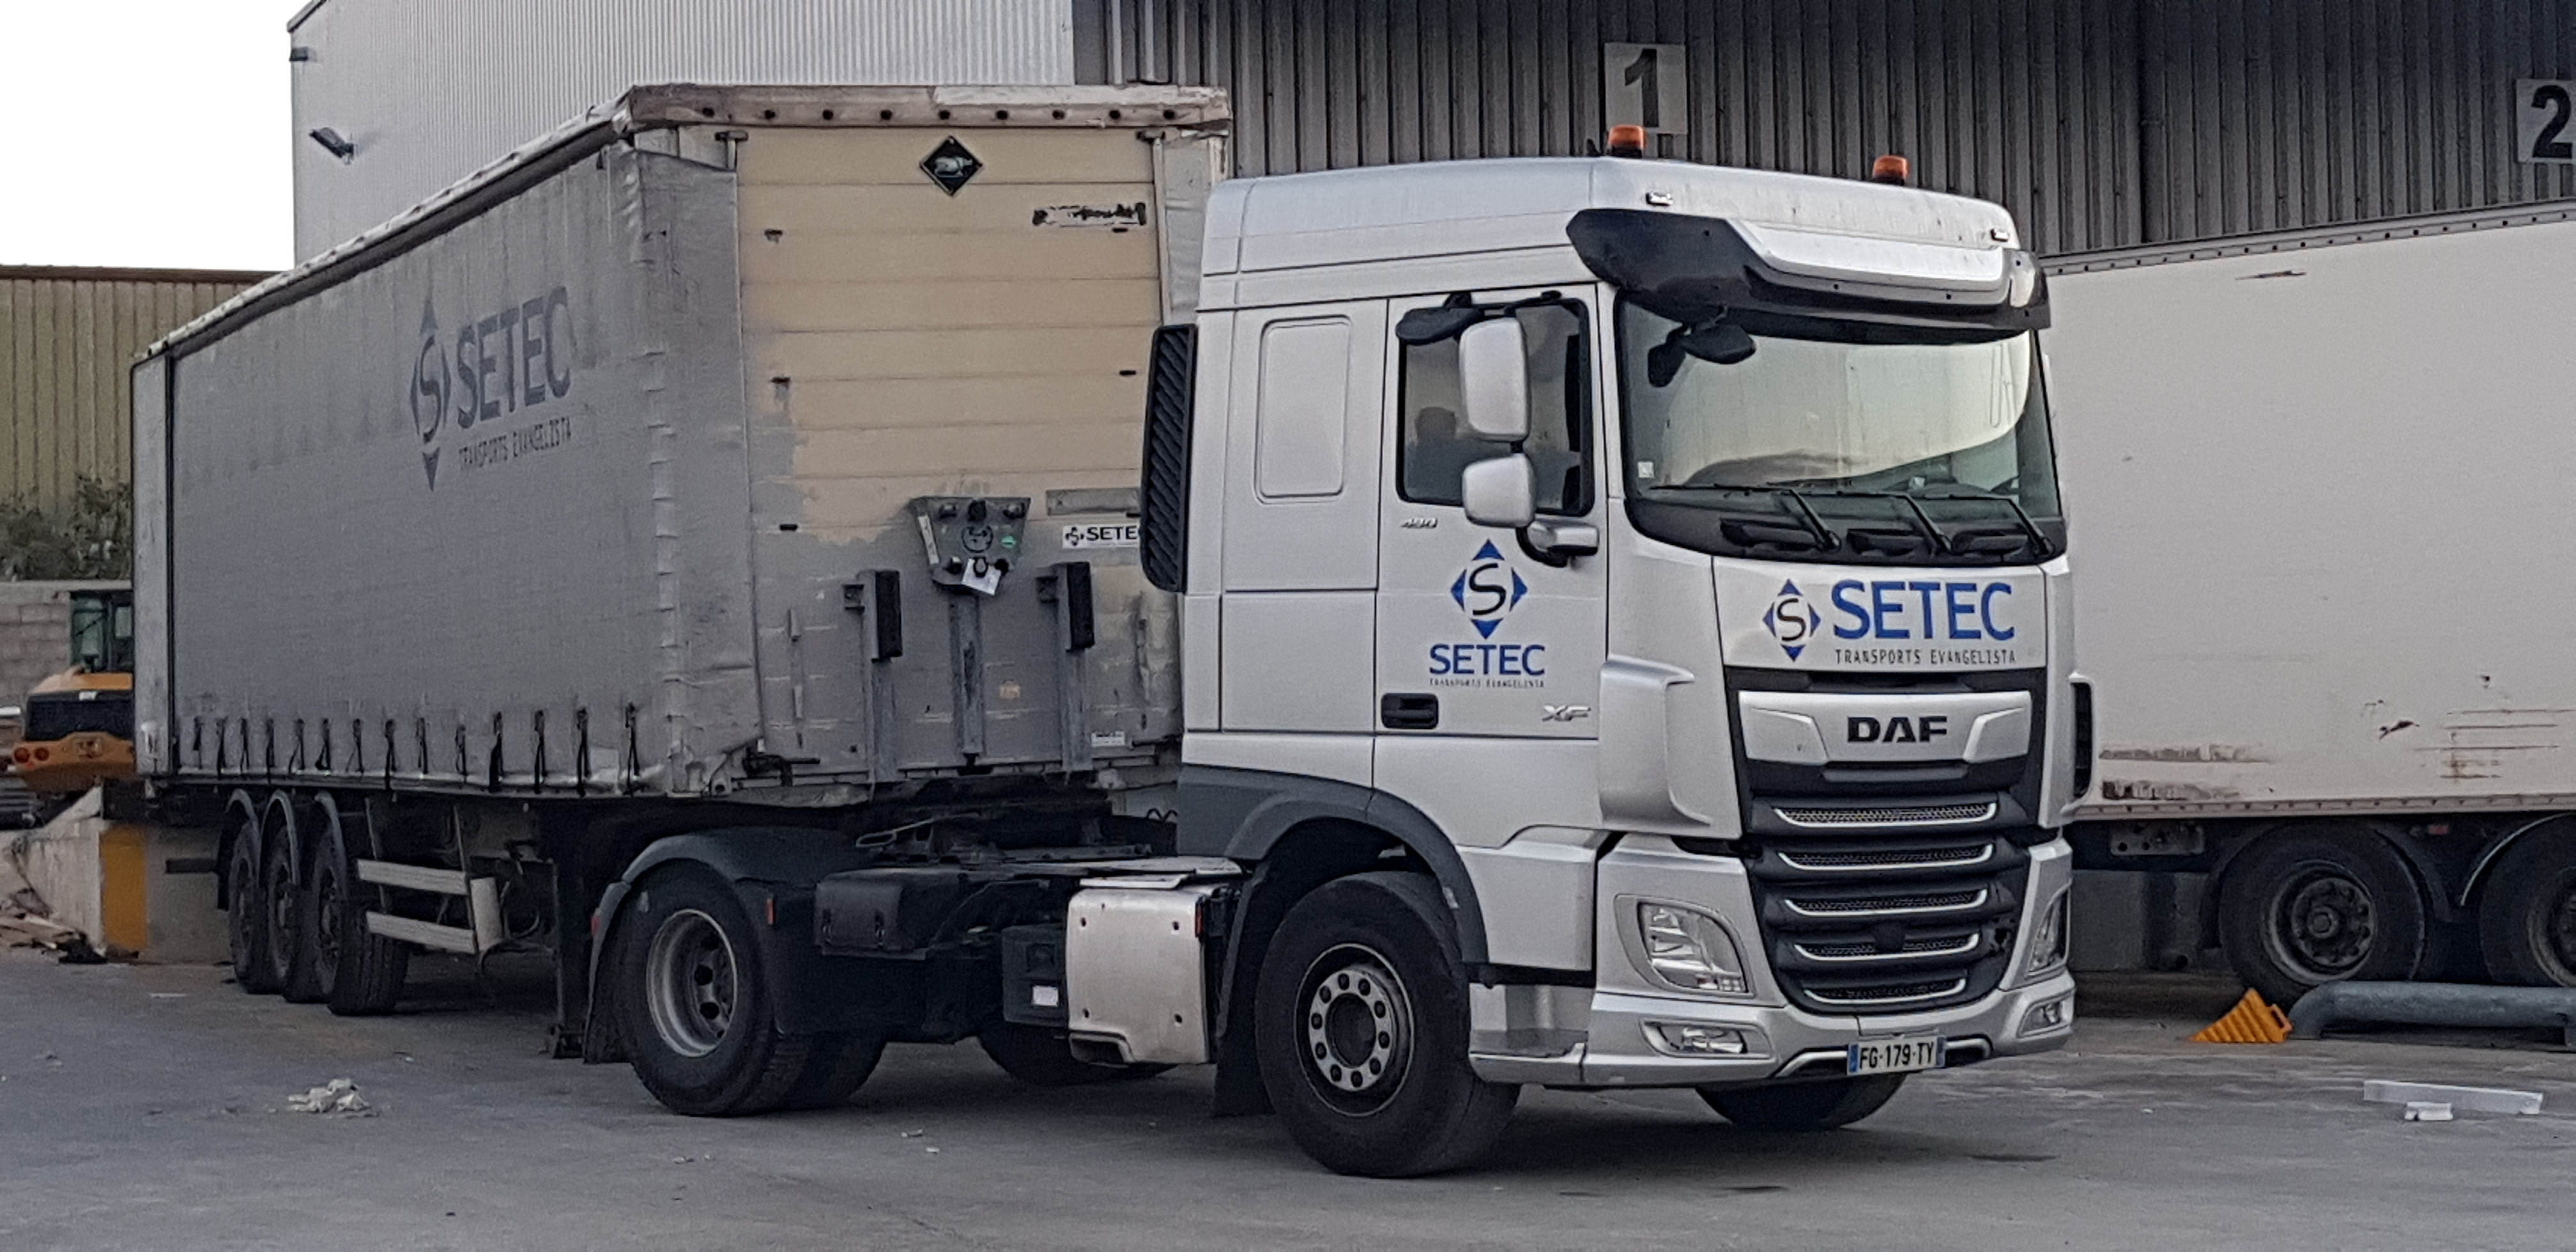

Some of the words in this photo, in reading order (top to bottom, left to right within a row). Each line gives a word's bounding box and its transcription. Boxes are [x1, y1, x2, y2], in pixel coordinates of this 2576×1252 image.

[1625, 49, 1659, 128] 1
[2531, 85, 2573, 158] 2
[457, 286, 572, 429] SETEC
[1086, 525, 1142, 541] SETE
[1469, 563, 1506, 616] S
[1777, 598, 1806, 641] S
[1831, 579, 2015, 641] SETEC
[1429, 644, 1545, 676] SETEC
[1835, 649, 1921, 665] TRANSPORTS
[1930, 649, 2016, 665] EVANGELISTA
[1542, 705, 1591, 722] XF
[1847, 715, 1948, 743] DAF
[1860, 1041, 1935, 1069] FG-179-TY
